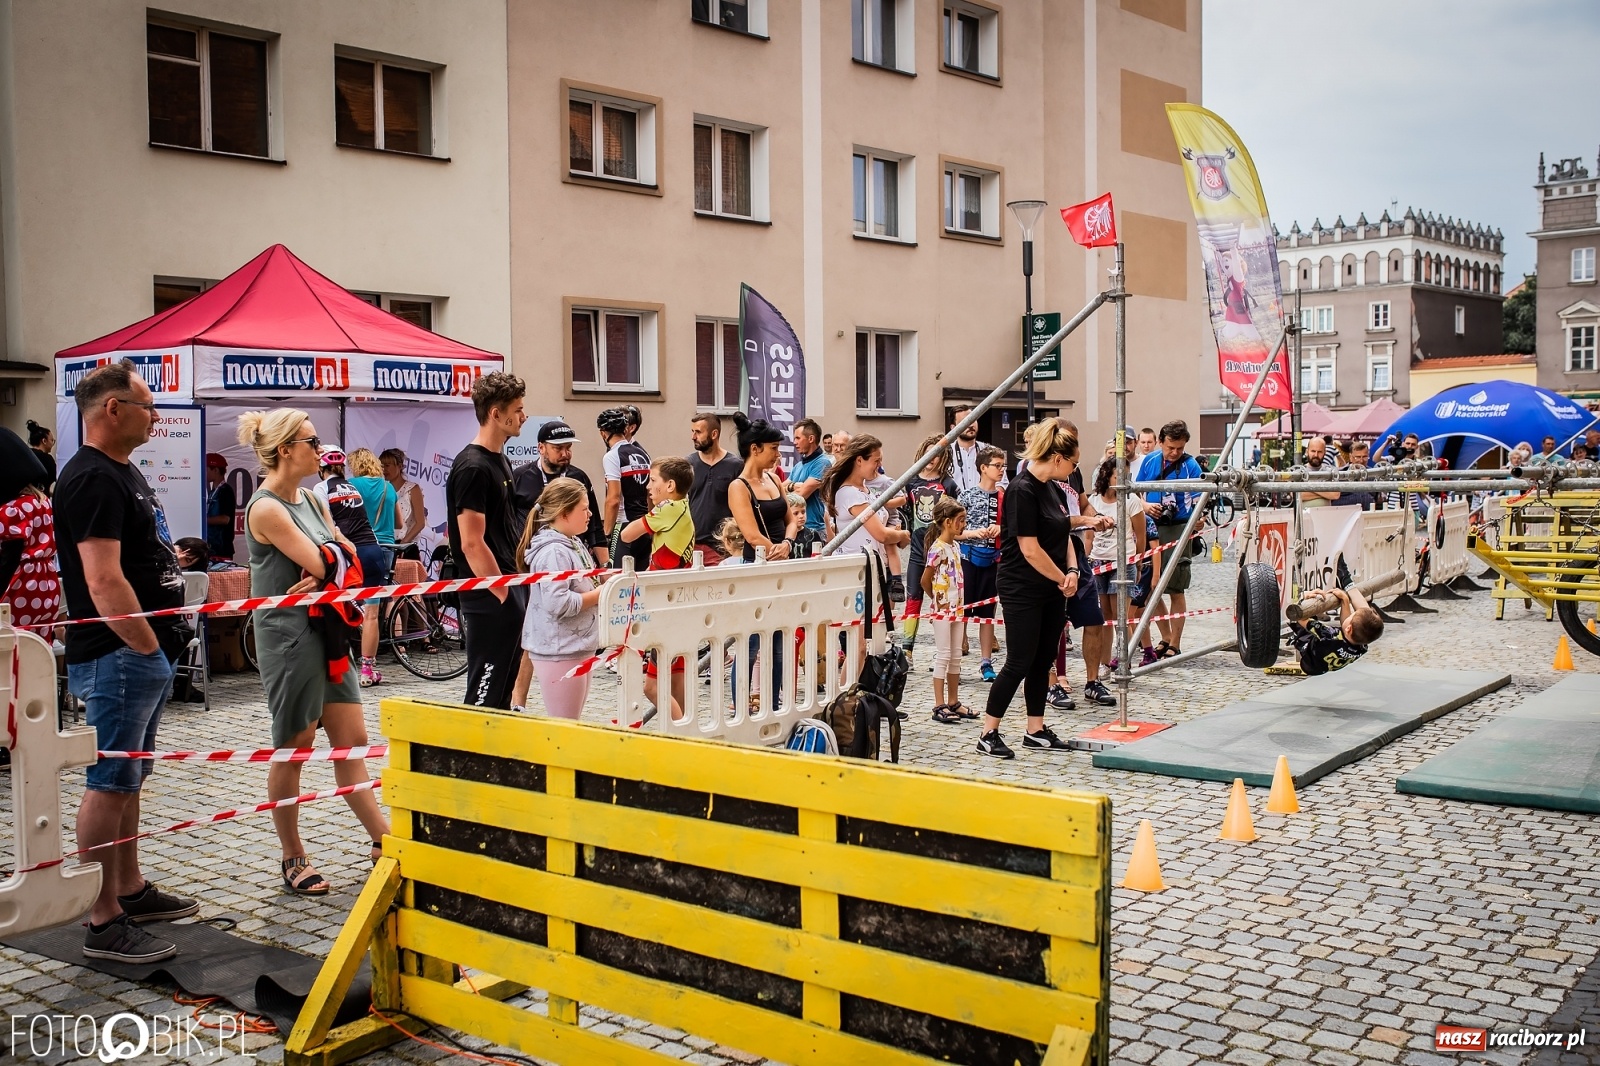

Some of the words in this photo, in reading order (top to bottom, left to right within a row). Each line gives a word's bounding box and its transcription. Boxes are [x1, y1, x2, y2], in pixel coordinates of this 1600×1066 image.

[226, 356, 344, 390] nowiny.pl
[1454, 409, 1507, 418] Raciborskie
[855, 591, 864, 614] 8
